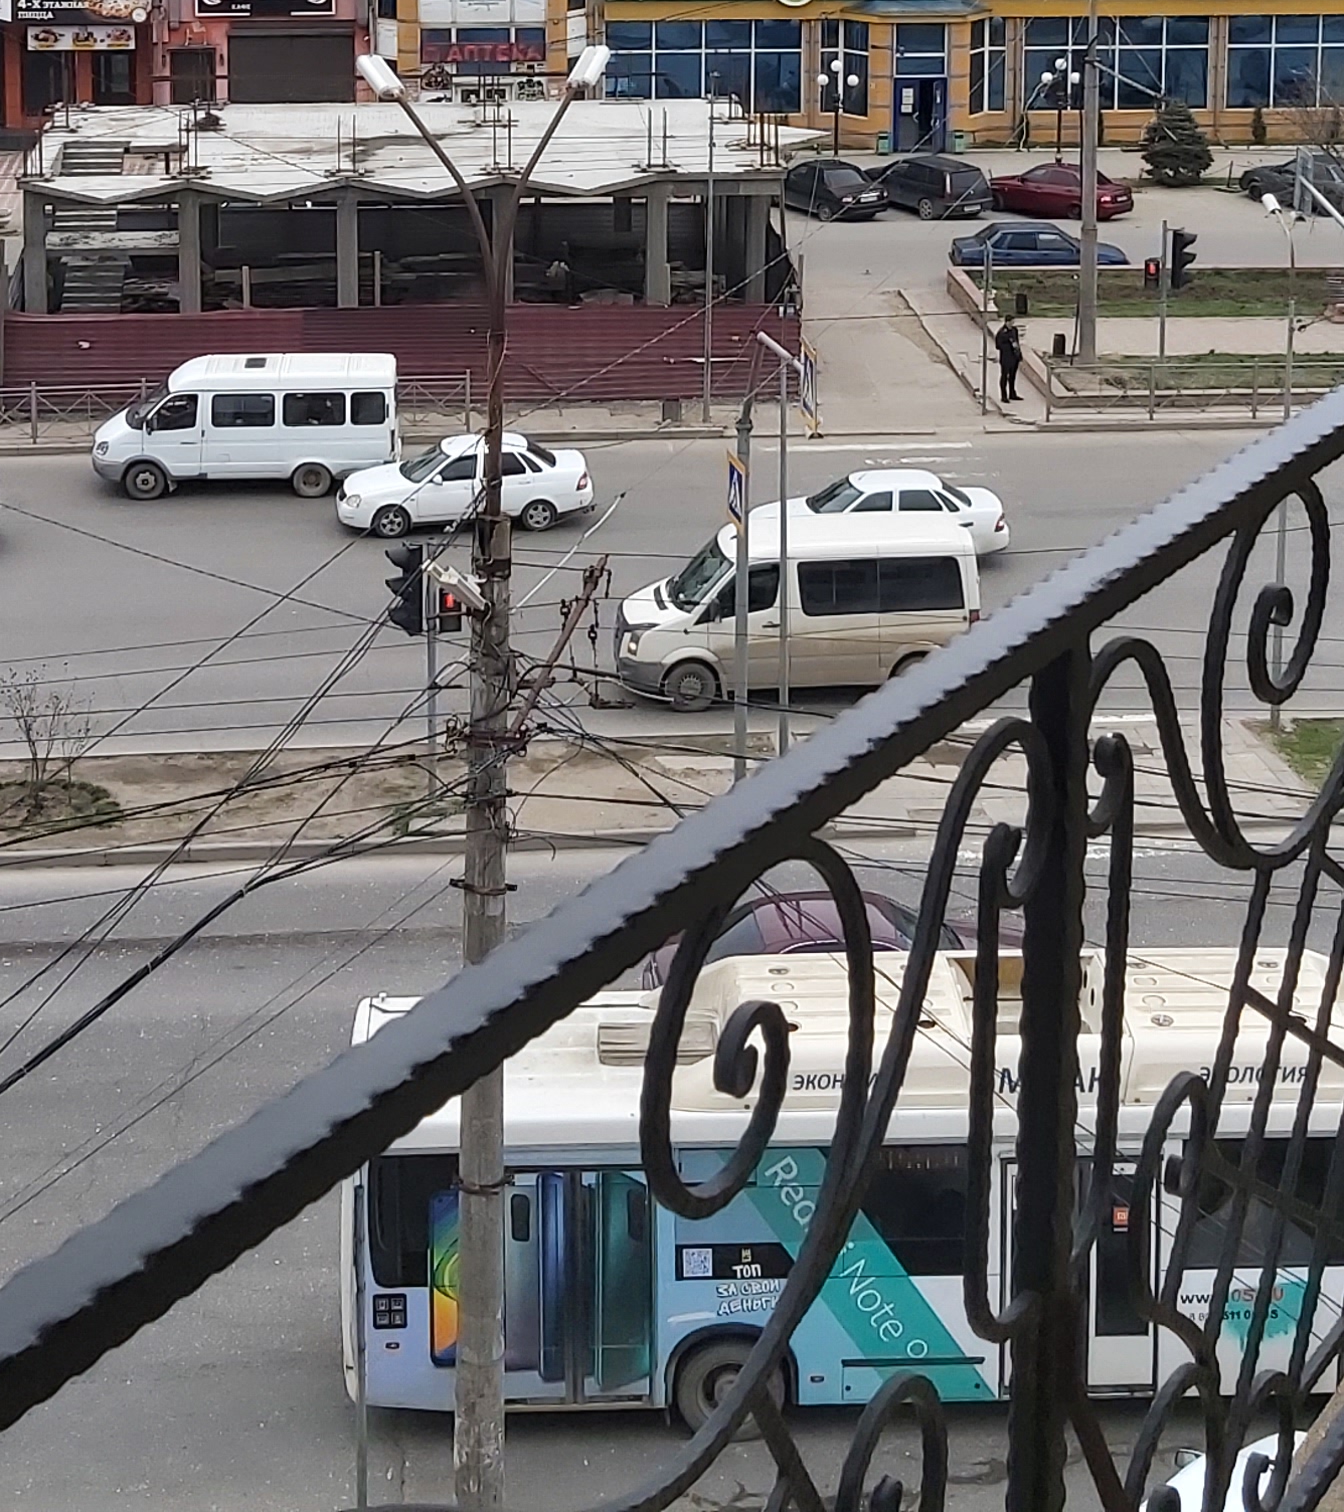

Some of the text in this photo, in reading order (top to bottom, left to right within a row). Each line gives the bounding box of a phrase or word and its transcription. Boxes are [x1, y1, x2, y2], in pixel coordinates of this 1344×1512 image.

[732, 1263, 762, 1279] ТОП
[716, 1278, 781, 1298] ЗА СВОИ
[839, 1258, 904, 1343] Note
